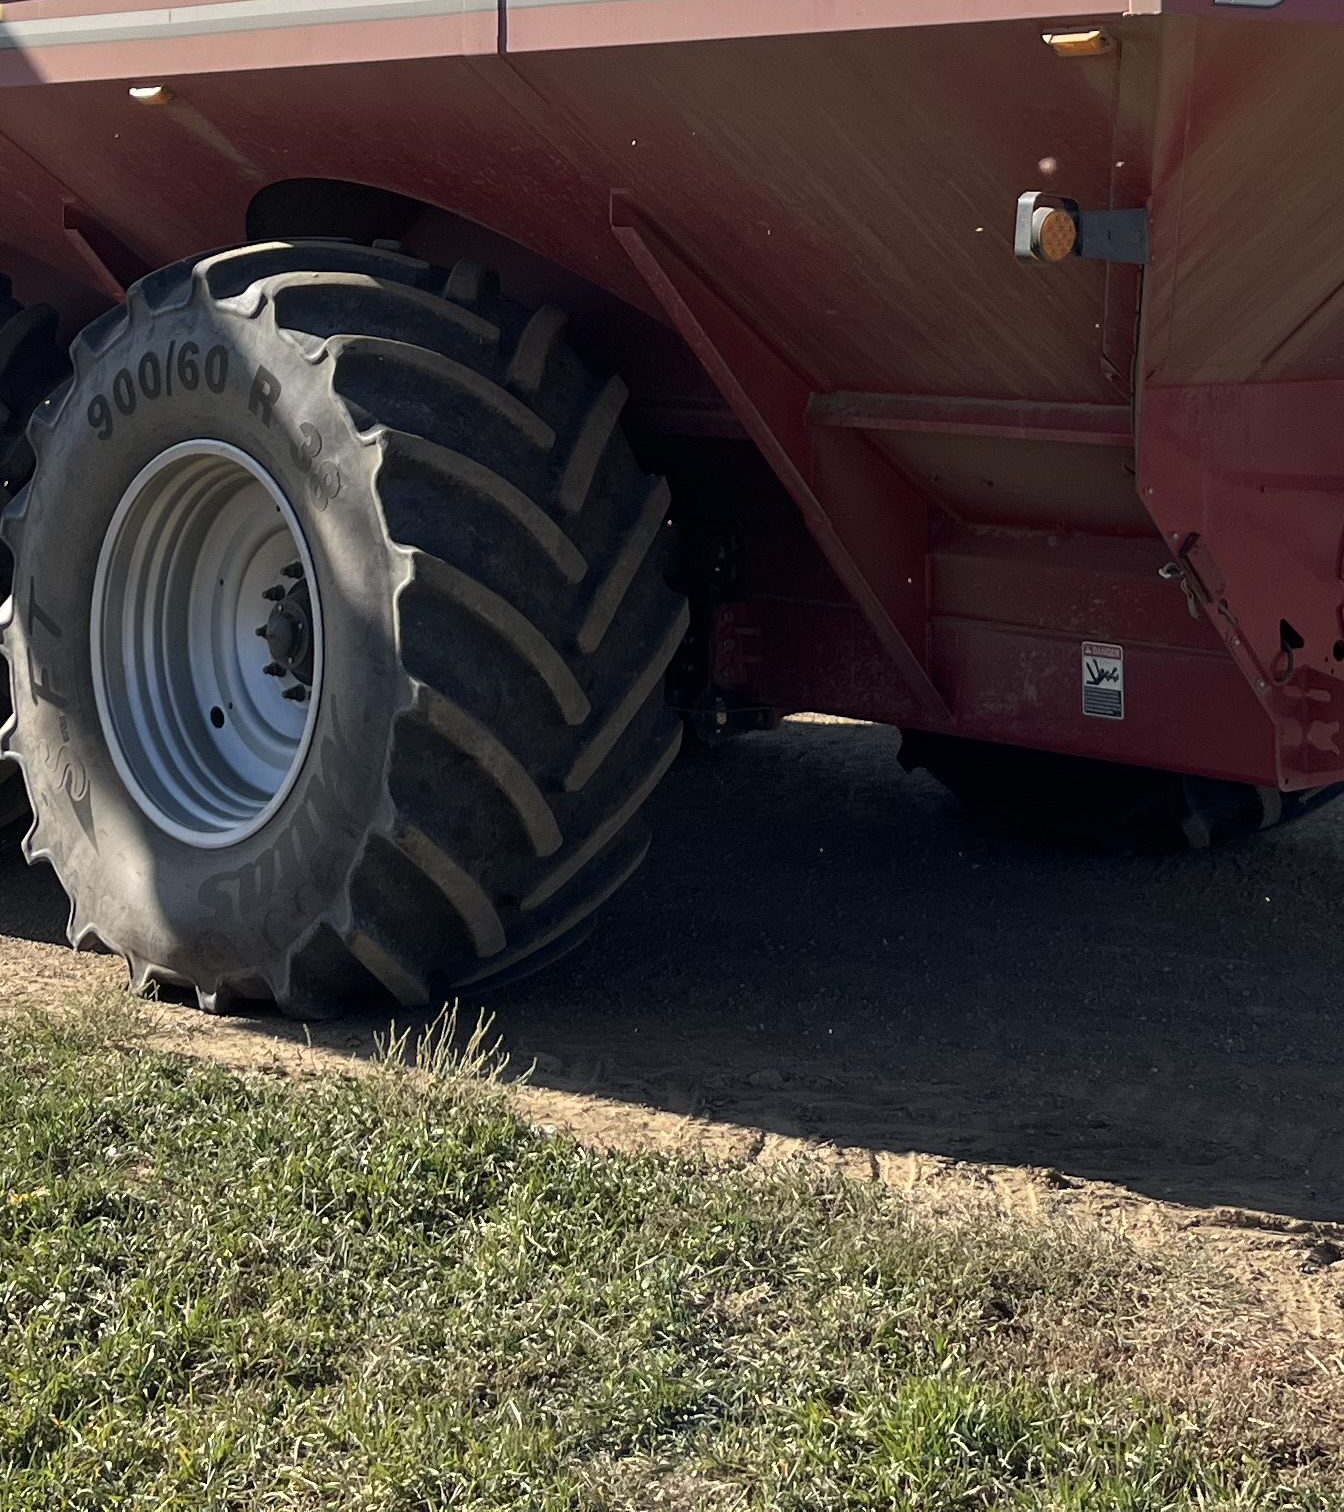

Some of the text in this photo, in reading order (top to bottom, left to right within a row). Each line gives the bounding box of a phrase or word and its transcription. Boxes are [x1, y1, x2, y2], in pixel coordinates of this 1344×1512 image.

[86, 340, 342, 512] 900/60 R 38
